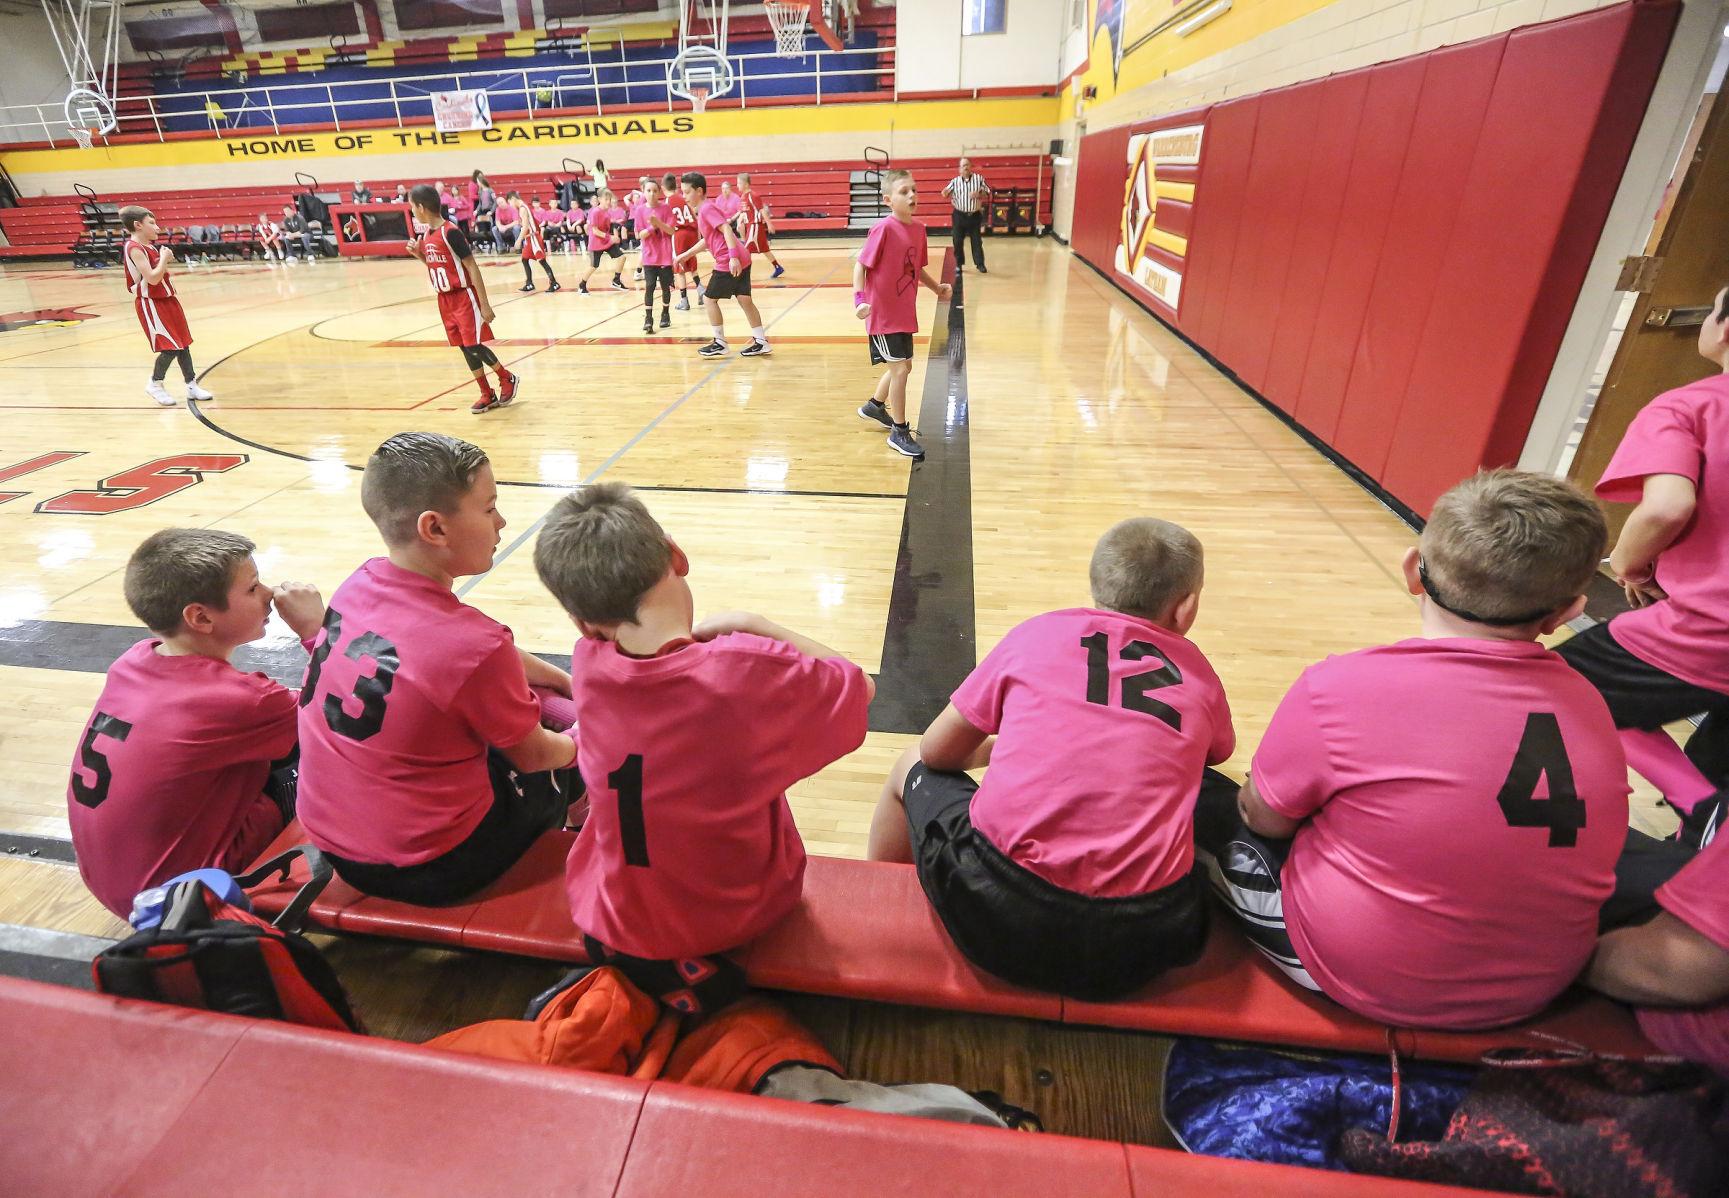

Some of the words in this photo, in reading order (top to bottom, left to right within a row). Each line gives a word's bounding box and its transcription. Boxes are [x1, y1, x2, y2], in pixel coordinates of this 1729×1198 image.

[227, 138, 316, 156] HOME
[334, 135, 373, 150] OF
[393, 131, 461, 146] THE
[481, 117, 694, 142] CARDINALS
[672, 204, 694, 225] 34
[1080, 631, 1183, 732] 12
[71, 711, 133, 810] 5
[607, 753, 650, 867] 1
[1497, 712, 1587, 848] 4
